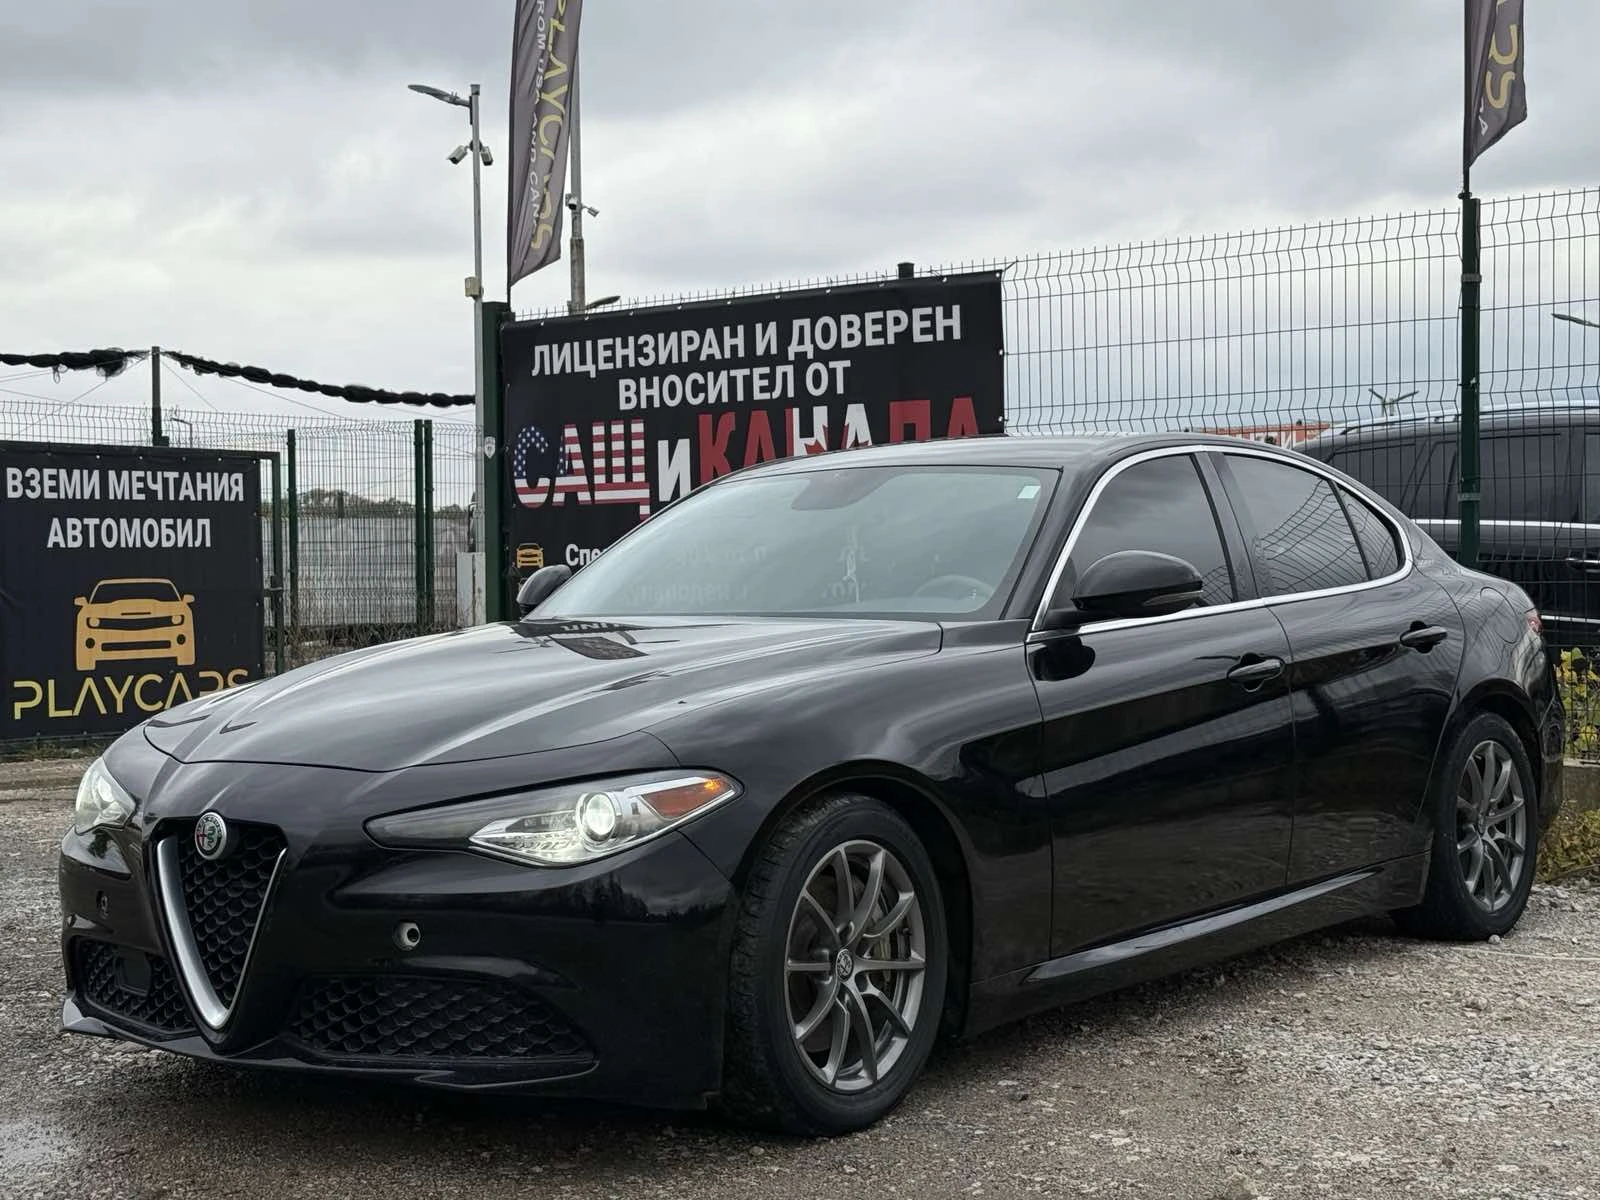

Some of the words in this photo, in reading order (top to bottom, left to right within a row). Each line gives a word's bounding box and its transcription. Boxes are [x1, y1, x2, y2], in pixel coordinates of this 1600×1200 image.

[537, 0, 546, 50] ROM
[531, 321, 746, 379] ЛИЦЕНЗИРАН
[755, 320, 778, 357] И
[787, 304, 962, 360] ДОВЕРЕН
[618, 365, 795, 411] ВНОСИТЕЛ
[805, 359, 852, 397] ОТ
[6, 466, 101, 500] ВЗЕМИ
[108, 469, 245, 502] МЕЧТАНИЯ
[513, 418, 651, 521] САЩ
[47, 517, 212, 549] АВТОМОБИЛ
